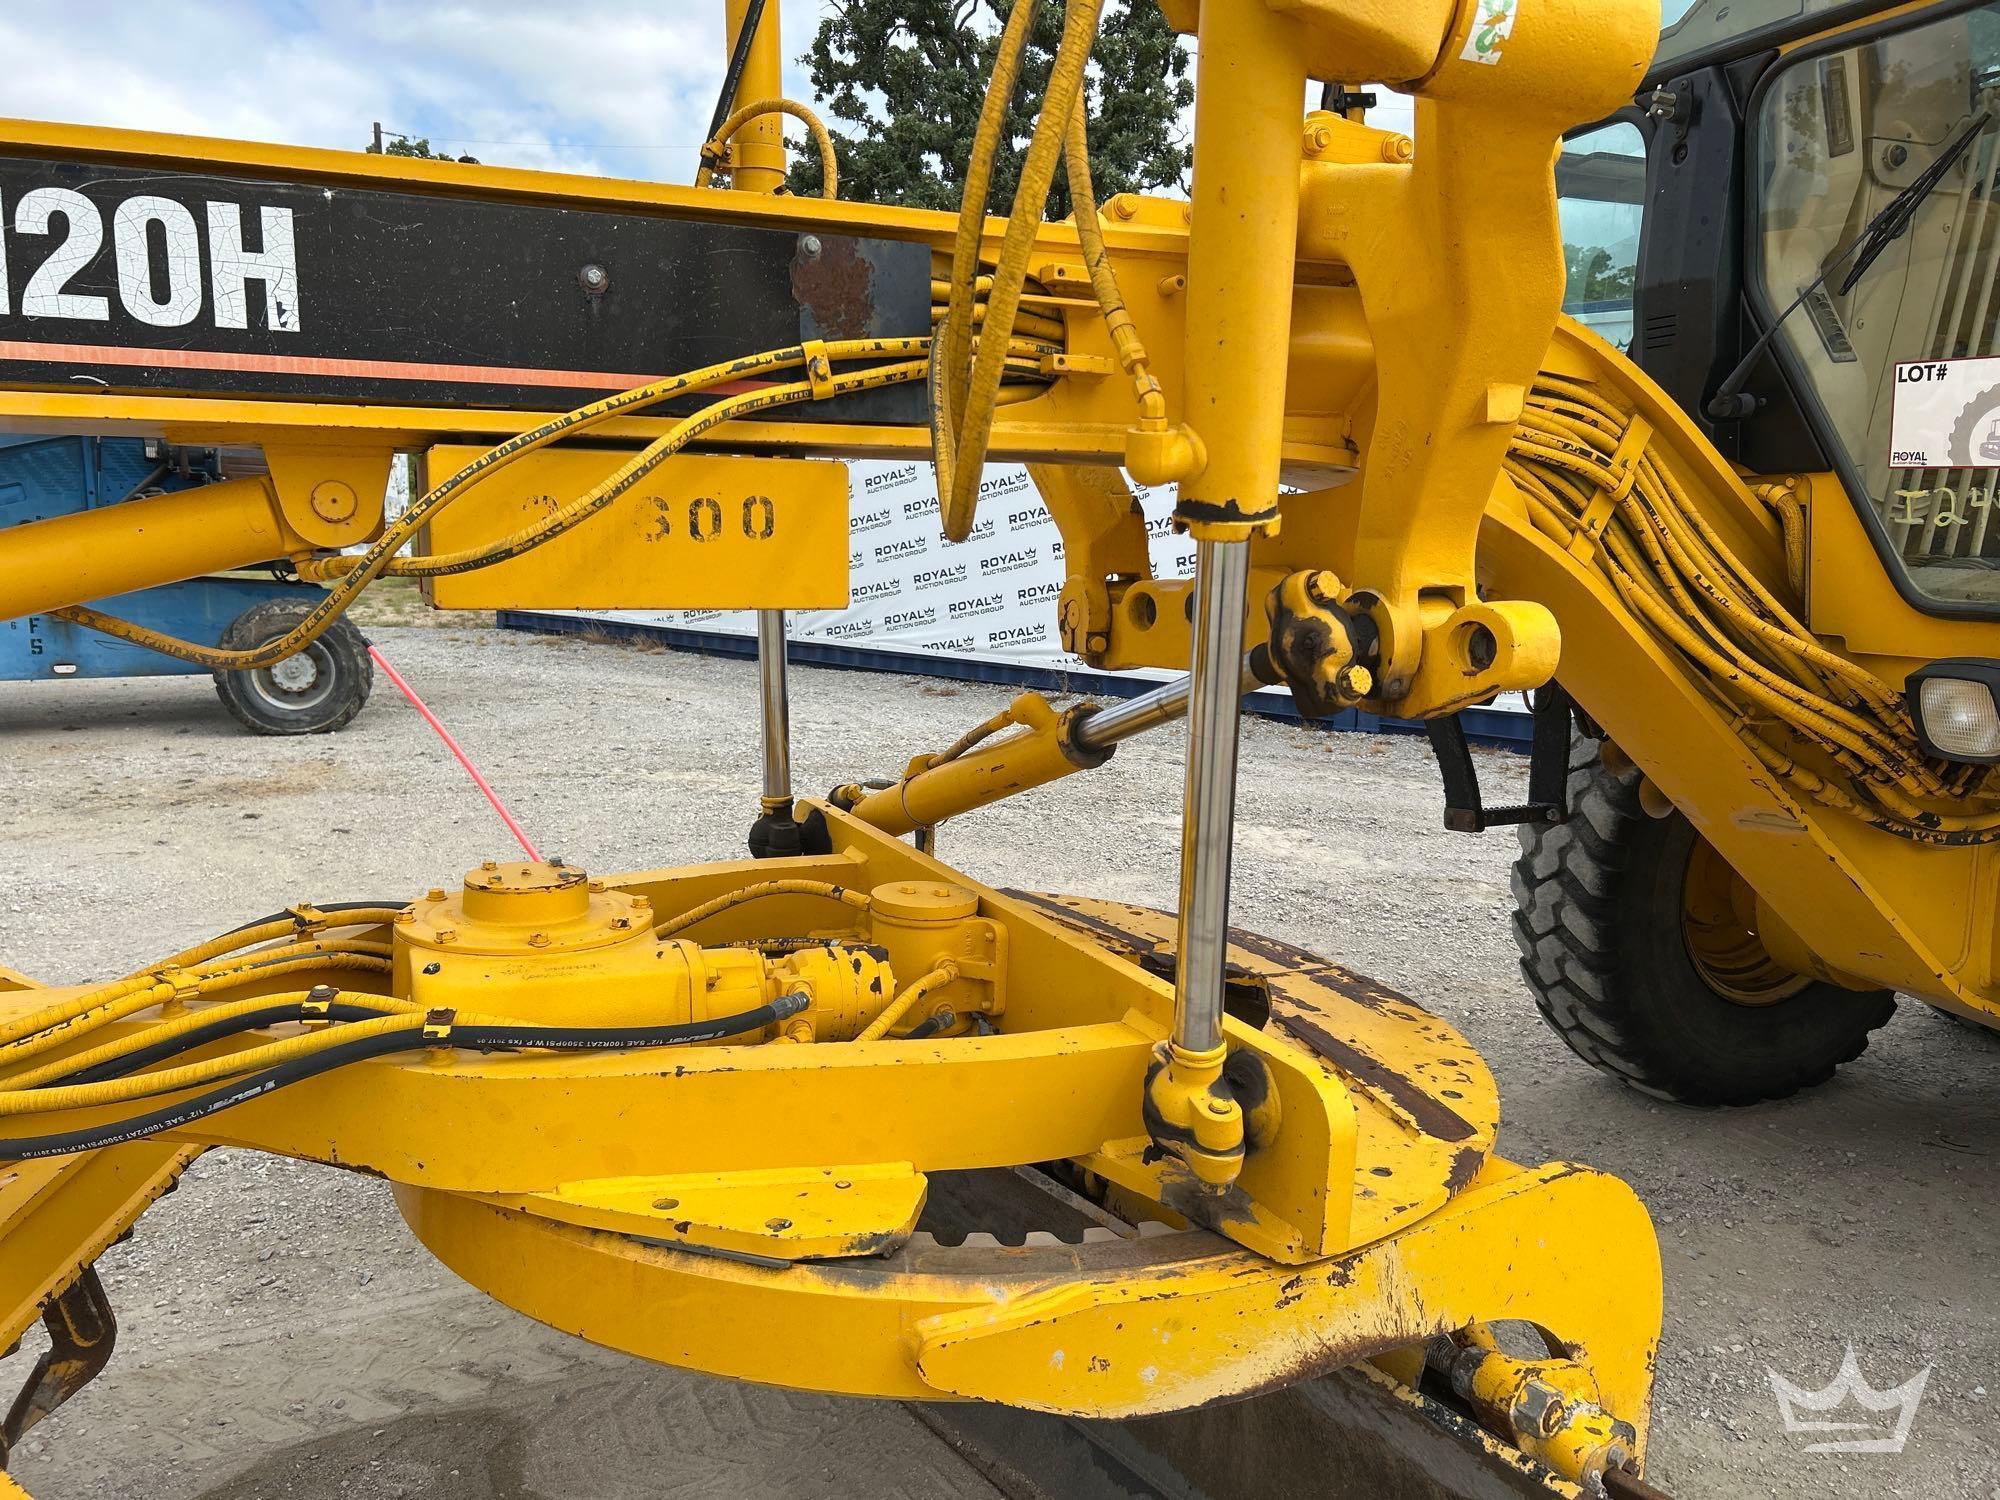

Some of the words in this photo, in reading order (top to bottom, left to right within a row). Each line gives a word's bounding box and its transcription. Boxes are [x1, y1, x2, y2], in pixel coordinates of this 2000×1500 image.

[0, 187, 300, 332] 20H
[1898, 364, 1947, 383] LOT#
[1893, 452, 1927, 461] ROYAL
[865, 470, 905, 487] ROYAL
[867, 483, 893, 494] AUCTION
[895, 476, 917, 487] GROUP
[979, 476, 1015, 493] OYAL
[1004, 483, 1028, 494] GROUP
[904, 497, 939, 513] ROYA
[850, 513, 880, 527] OYAL
[905, 508, 934, 520] AUCTION
[1009, 507, 1048, 524] ROYA
[871, 520, 892, 529] GROUP
[1010, 518, 1042, 531] AUCTION
[972, 531, 996, 541] GROUP
[875, 540, 915, 557] ROYAL
[877, 553, 904, 563] AUCTION
[905, 547, 927, 557] GROUP
[980, 552, 1025, 569] ROYAL
[982, 565, 1013, 576] AUCTION
[1014, 560, 1038, 570] GROUP
[914, 567, 955, 584] ROYAL
[915, 580, 943, 591] AUCTION
[945, 575, 968, 585] GROUP
[852, 581, 890, 597] ROYAL
[853, 594, 879, 604] AUCTION
[880, 589, 902, 598] GROUP
[949, 597, 992, 613] ROYAL
[1019, 596, 1051, 607] AUCTION
[685, 616, 705, 624] AUCTION
[706, 612, 722, 620] GROUP
[885, 610, 924, 625] ROYAL
[950, 609, 980, 620] AUCTION
[980, 605, 1004, 614] GROUP
[826, 622, 862, 636] ROYAL
[886, 622, 914, 632] AUCTION
[914, 618, 937, 627] GROUP
[853, 629, 874, 638] GROUP
[989, 627, 1033, 642] ROYAL
[990, 639, 1020, 649] AUCTION
[1021, 635, 1047, 645] GROUP
[165, 1115, 185, 1127] SAE
[88, 1133, 125, 1148] 3500PSI
